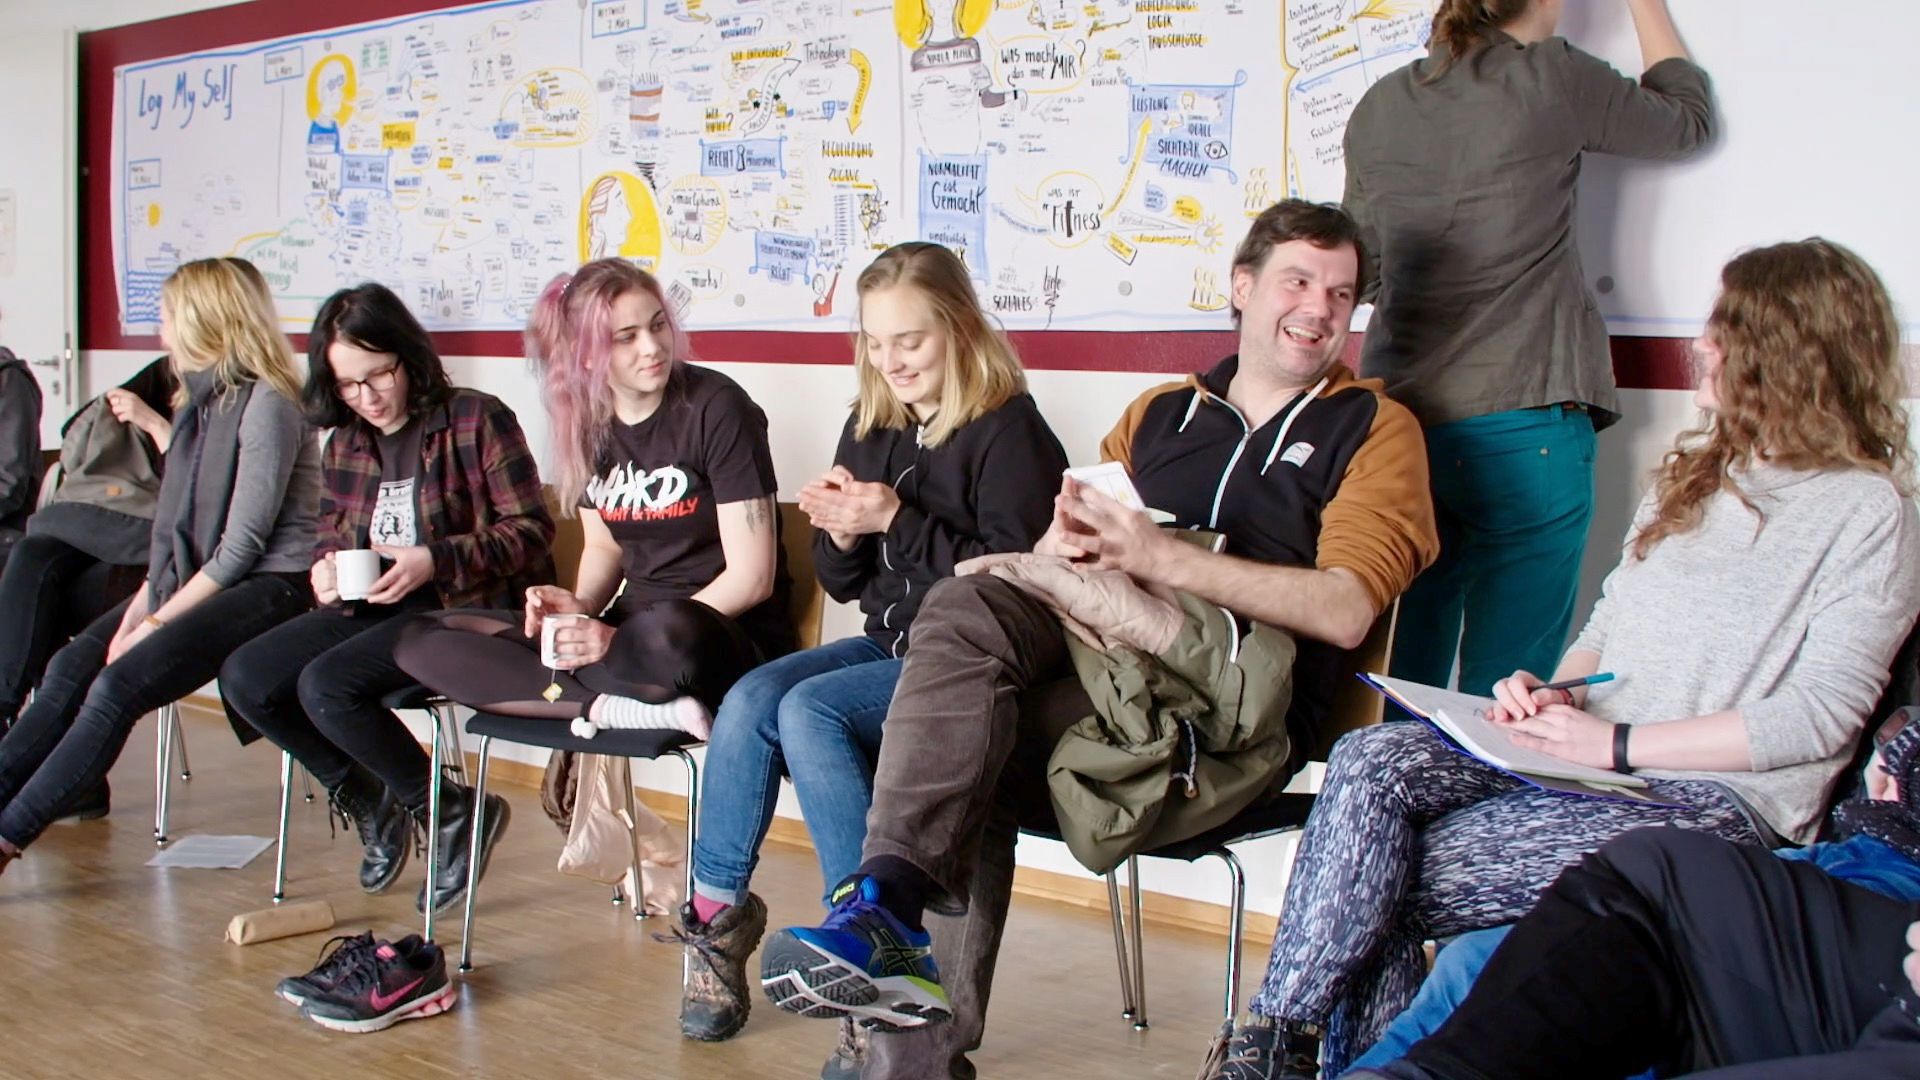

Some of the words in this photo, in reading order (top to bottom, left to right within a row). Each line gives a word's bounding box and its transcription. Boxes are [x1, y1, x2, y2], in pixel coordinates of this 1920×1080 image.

[1147, 14, 1172, 30] LOGIK
[139, 79, 163, 130] Log
[172, 71, 196, 129] My
[202, 64, 238, 120] Self
[708, 149, 734, 168] RECHT
[1157, 139, 1201, 159] SICHTBAR
[1160, 157, 1209, 178] MACHEN
